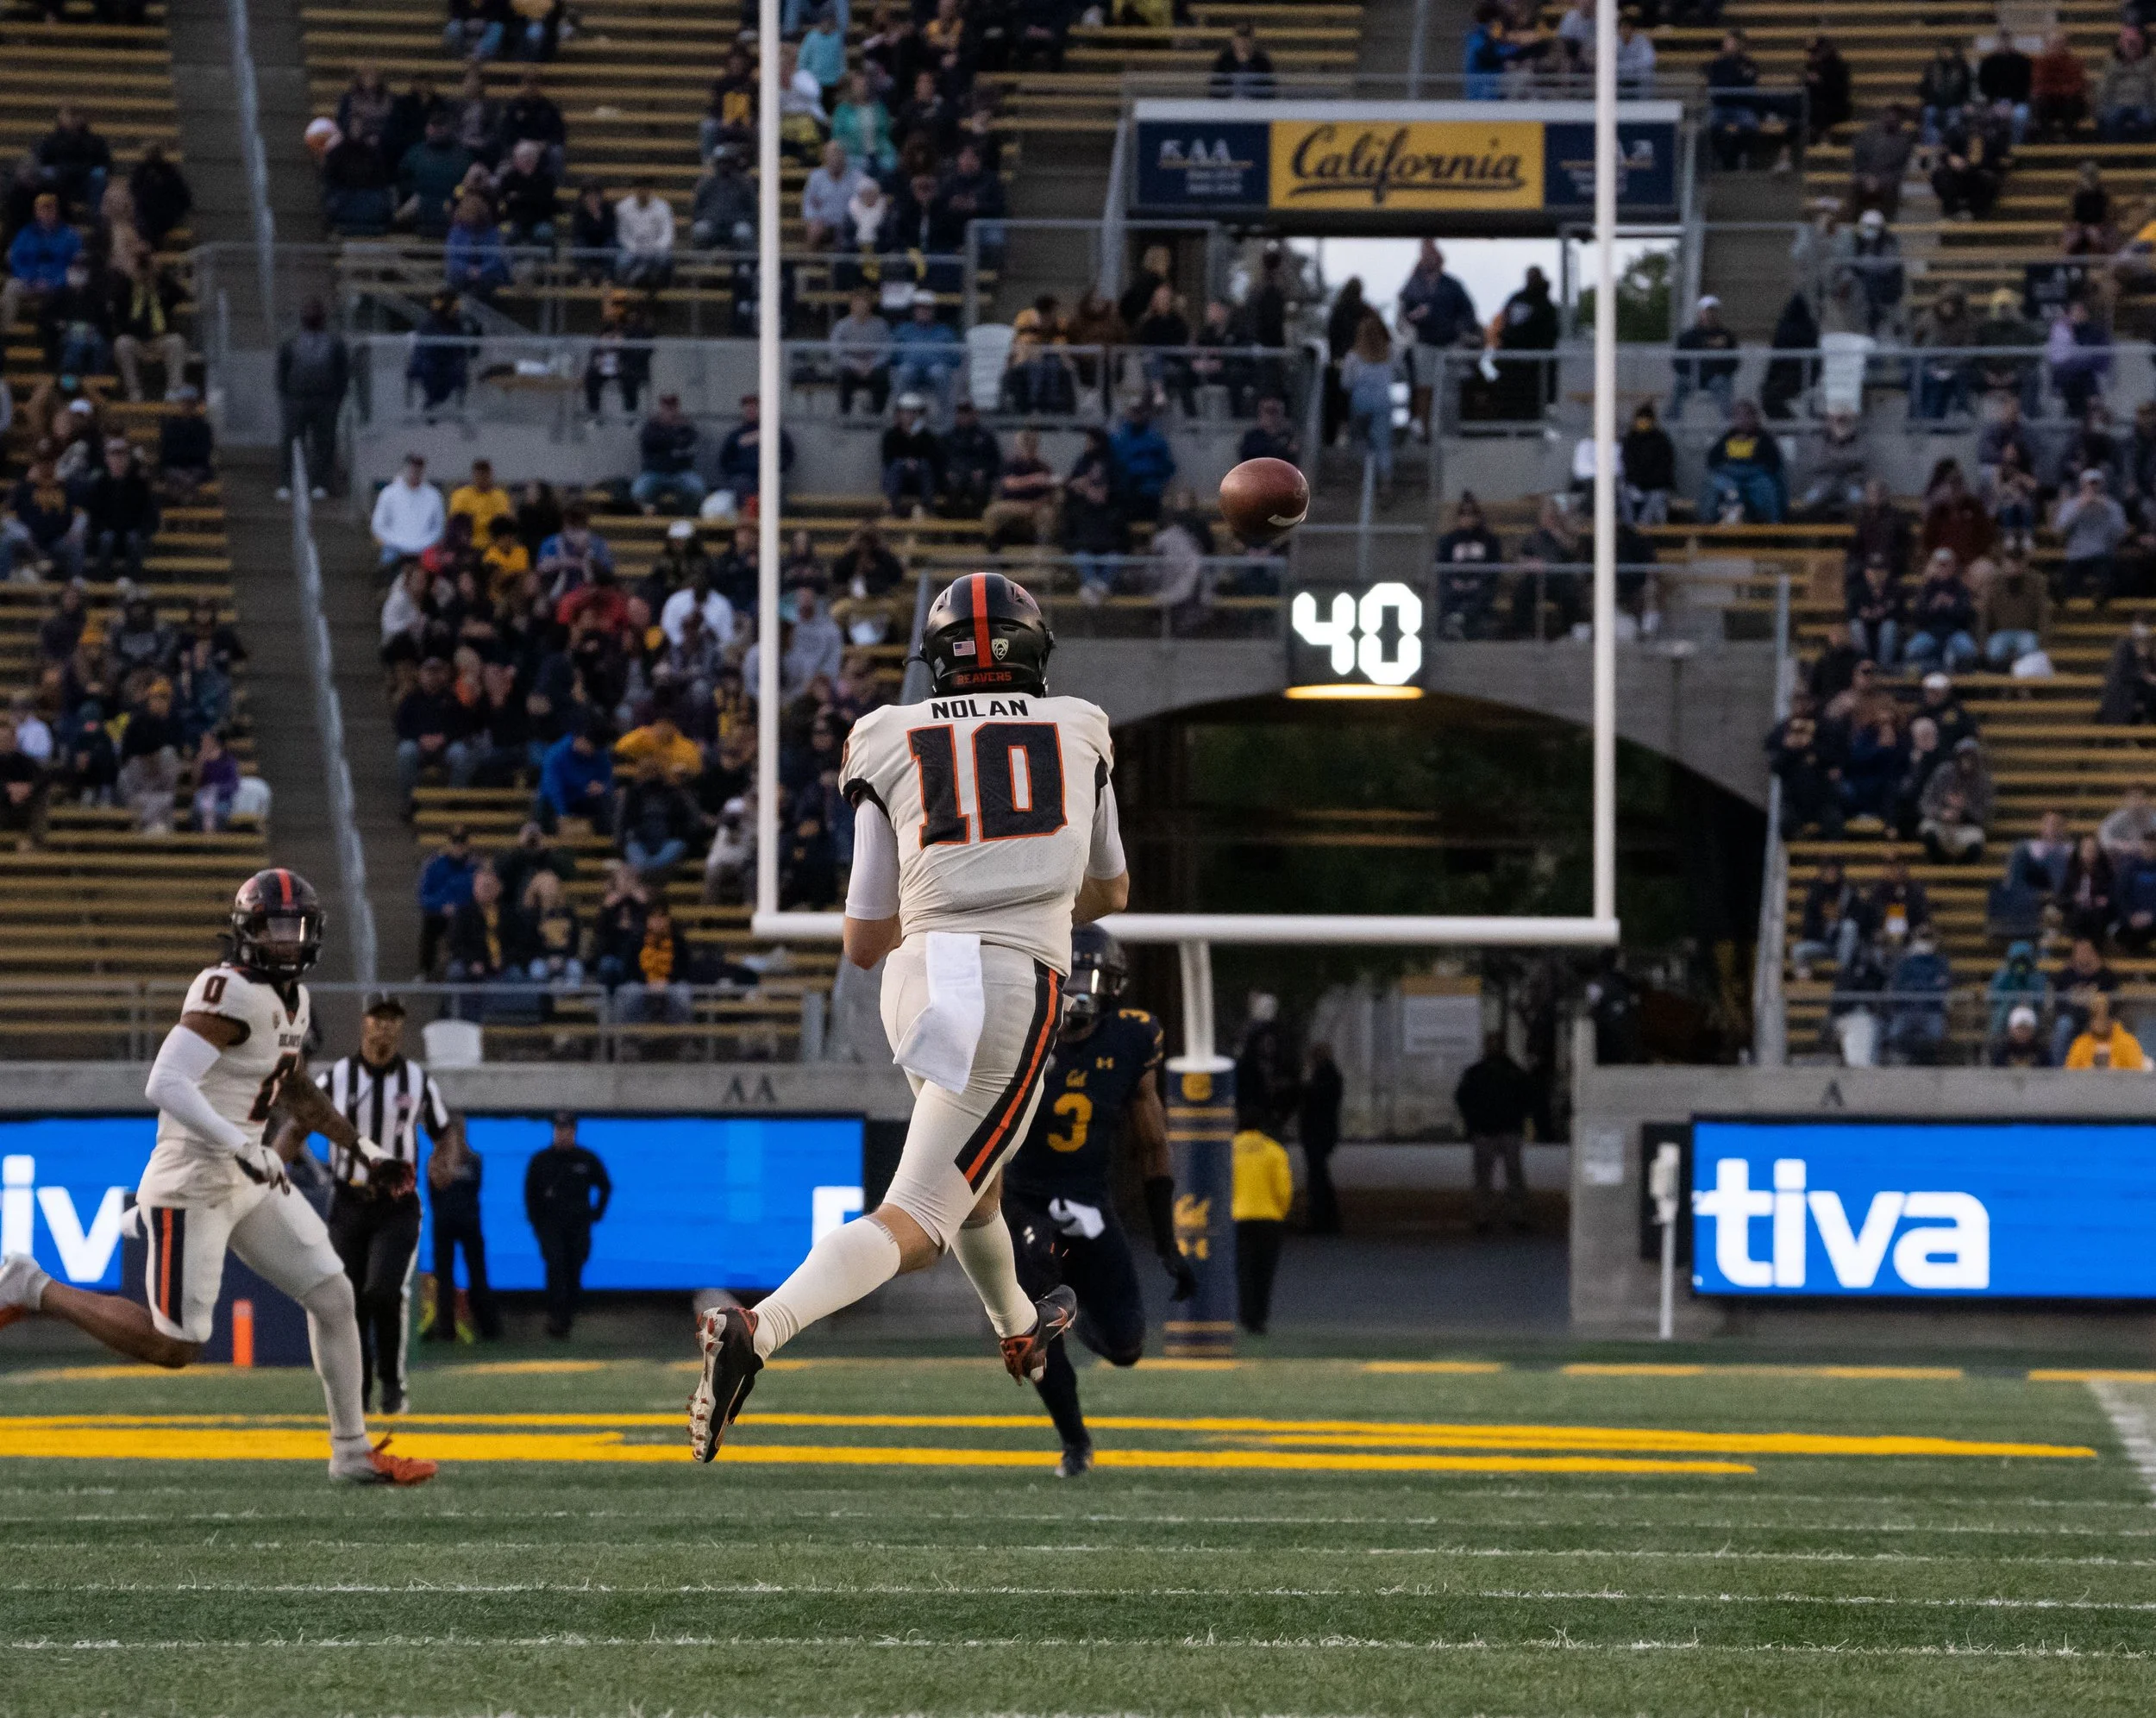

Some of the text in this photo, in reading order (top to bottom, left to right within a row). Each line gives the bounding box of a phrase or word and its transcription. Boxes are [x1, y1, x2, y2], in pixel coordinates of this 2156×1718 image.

[1289, 124, 1525, 204] California
[1292, 582, 1422, 685] 40
[931, 699, 1029, 718] NOLAN
[957, 672, 1012, 684] BEAVERS
[906, 722, 1069, 850] 10
[202, 975, 229, 1005] 0
[1046, 1093, 1094, 1152] 3
[1, 1154, 128, 1282] iv
[1692, 1158, 1990, 1288] tiva
